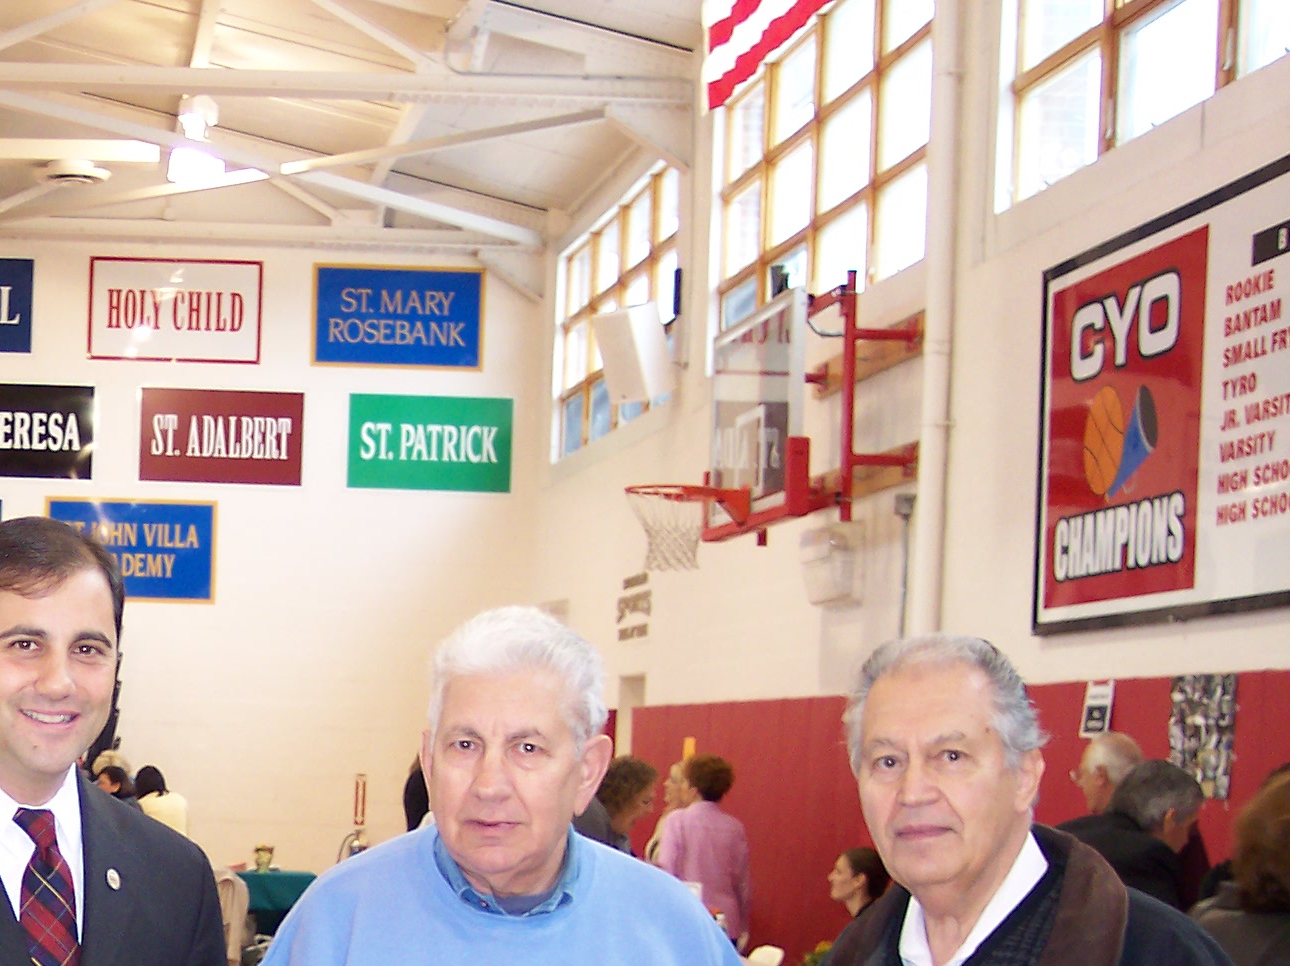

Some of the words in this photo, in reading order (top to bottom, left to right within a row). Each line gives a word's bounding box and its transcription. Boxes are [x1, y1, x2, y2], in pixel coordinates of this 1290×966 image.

[340, 288, 373, 314] ST.
[379, 289, 455, 317] MARY
[1225, 268, 1275, 306] ROOKIE
[106, 288, 162, 331] HOLY
[172, 290, 245, 333] CHILD
[1071, 269, 1181, 382] CYO
[1224, 298, 1282, 337] BANTAM
[328, 318, 466, 347] ROSEBANK
[1223, 335, 1267, 368] SMALL
[1222, 372, 1257, 401] TYRO
[150, 413, 180, 457] ST.
[185, 415, 291, 460] ADALBERT
[1220, 408, 1240, 432] JR.
[359, 422, 394, 461] ST.
[399, 424, 499, 464] PATRICK
[1220, 430, 1276, 463] VARSITY
[1217, 469, 1248, 495] HIGH
[1253, 459, 1290, 486] SCHO
[1216, 501, 1247, 526] HIGH
[1252, 492, 1290, 519] SCHO
[143, 523, 199, 548] VILLA
[1054, 489, 1185, 583] CHAMPIONS
[112, 552, 176, 578] DEMY
